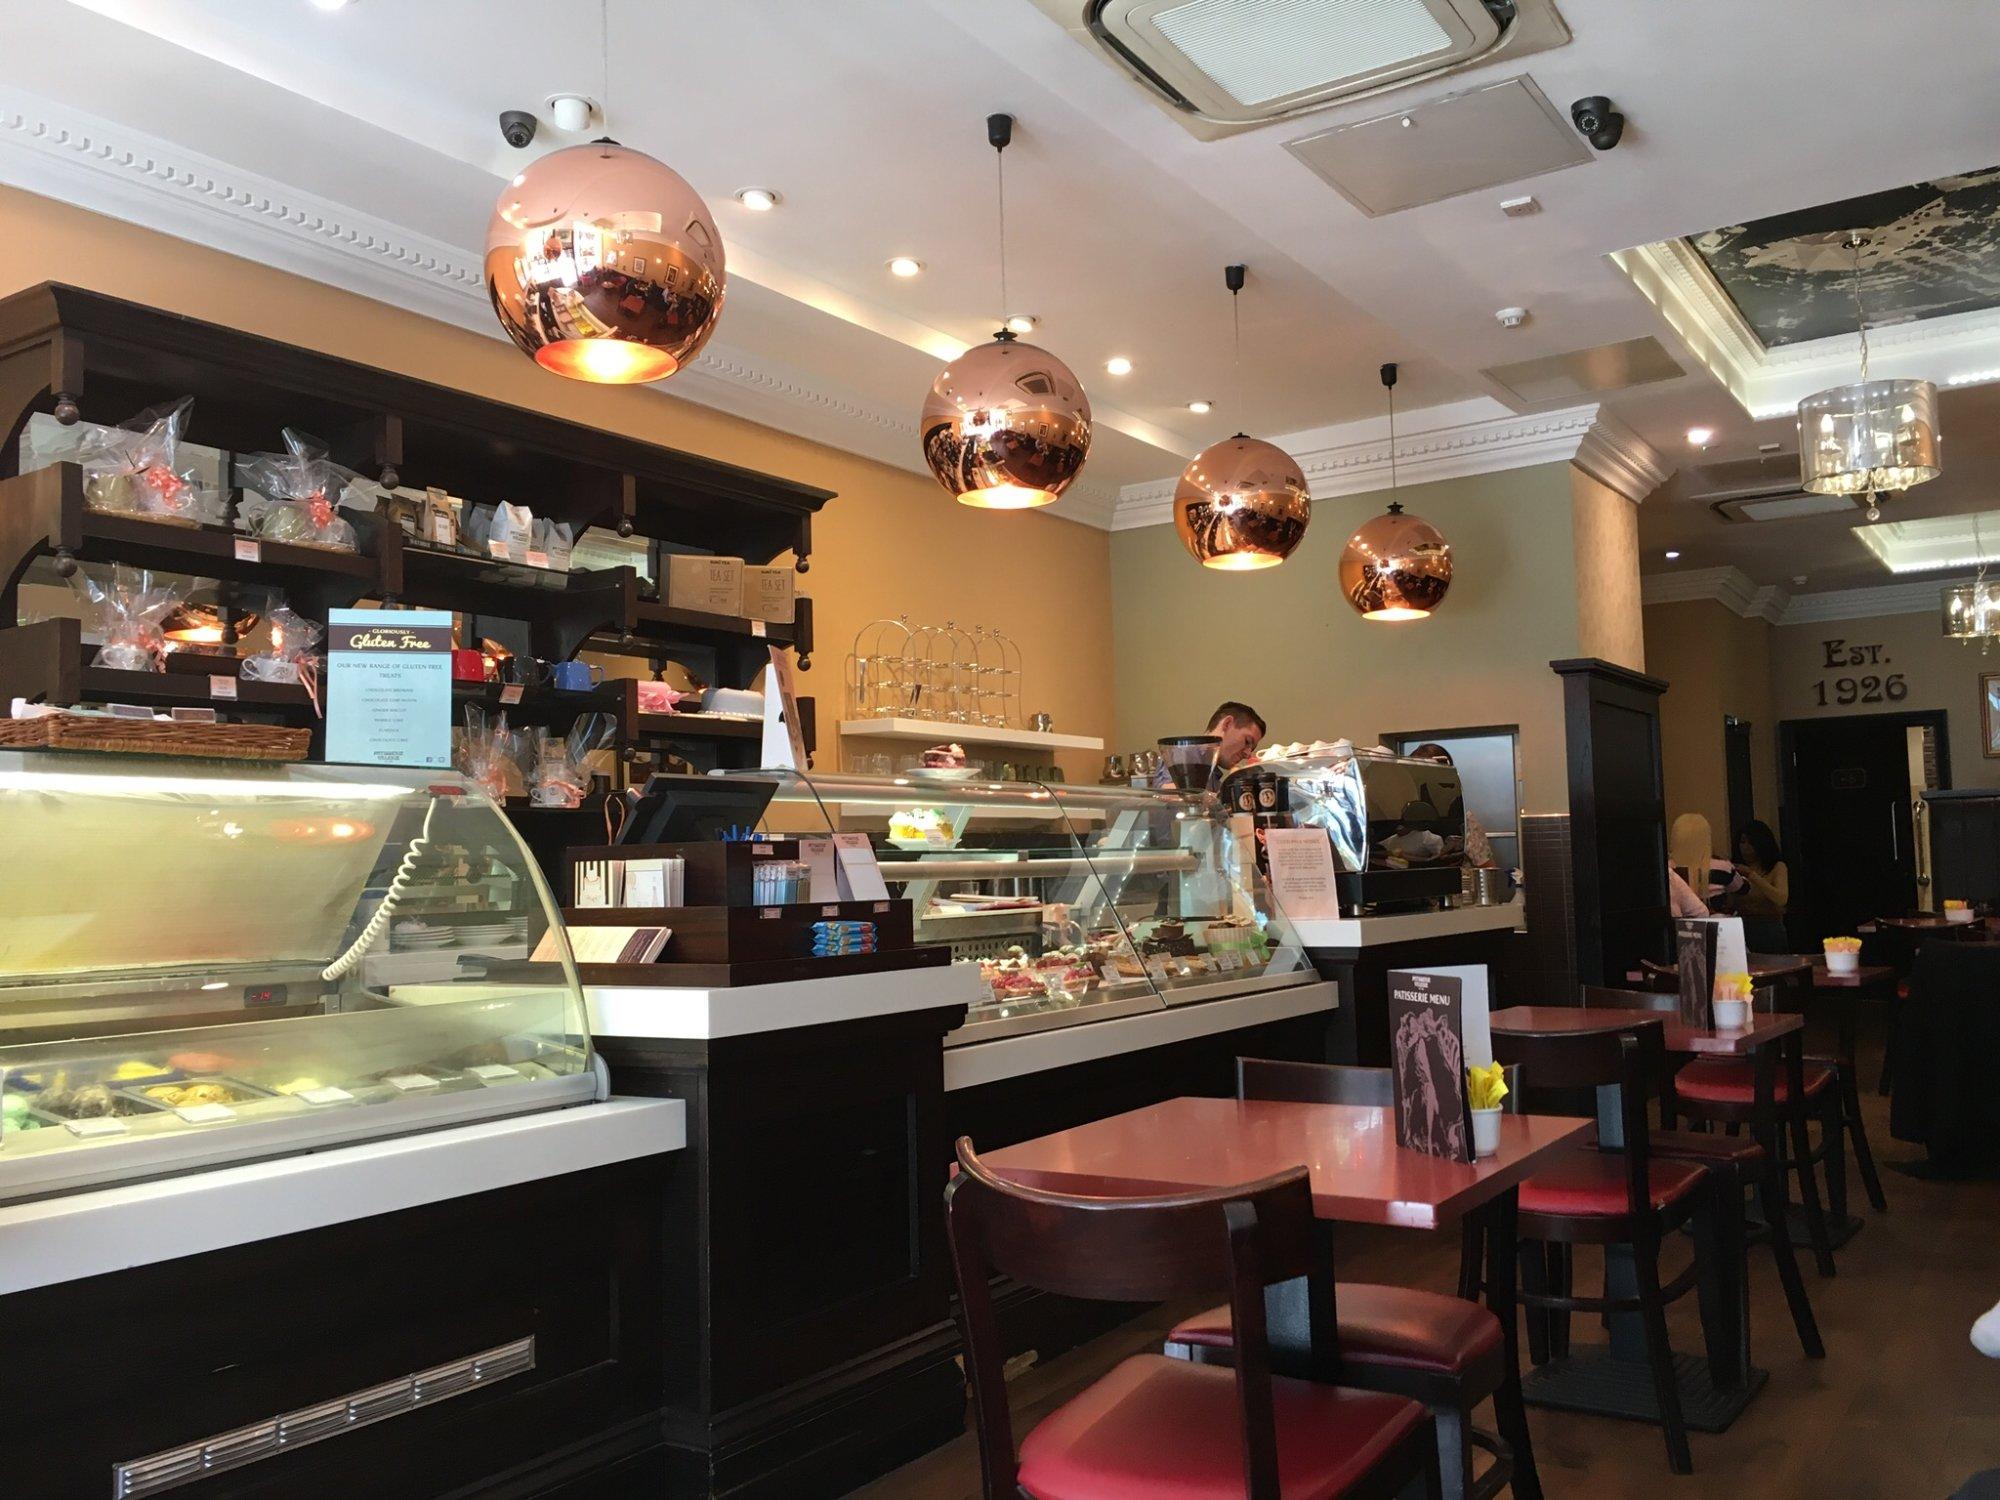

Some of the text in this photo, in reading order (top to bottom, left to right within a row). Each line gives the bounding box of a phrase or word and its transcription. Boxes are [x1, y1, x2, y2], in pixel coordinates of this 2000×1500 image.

[350, 633, 432, 649] Gluten Free
[1812, 673, 1908, 707] 1926
[1394, 989, 1451, 1006] PATISSERIE MENU
